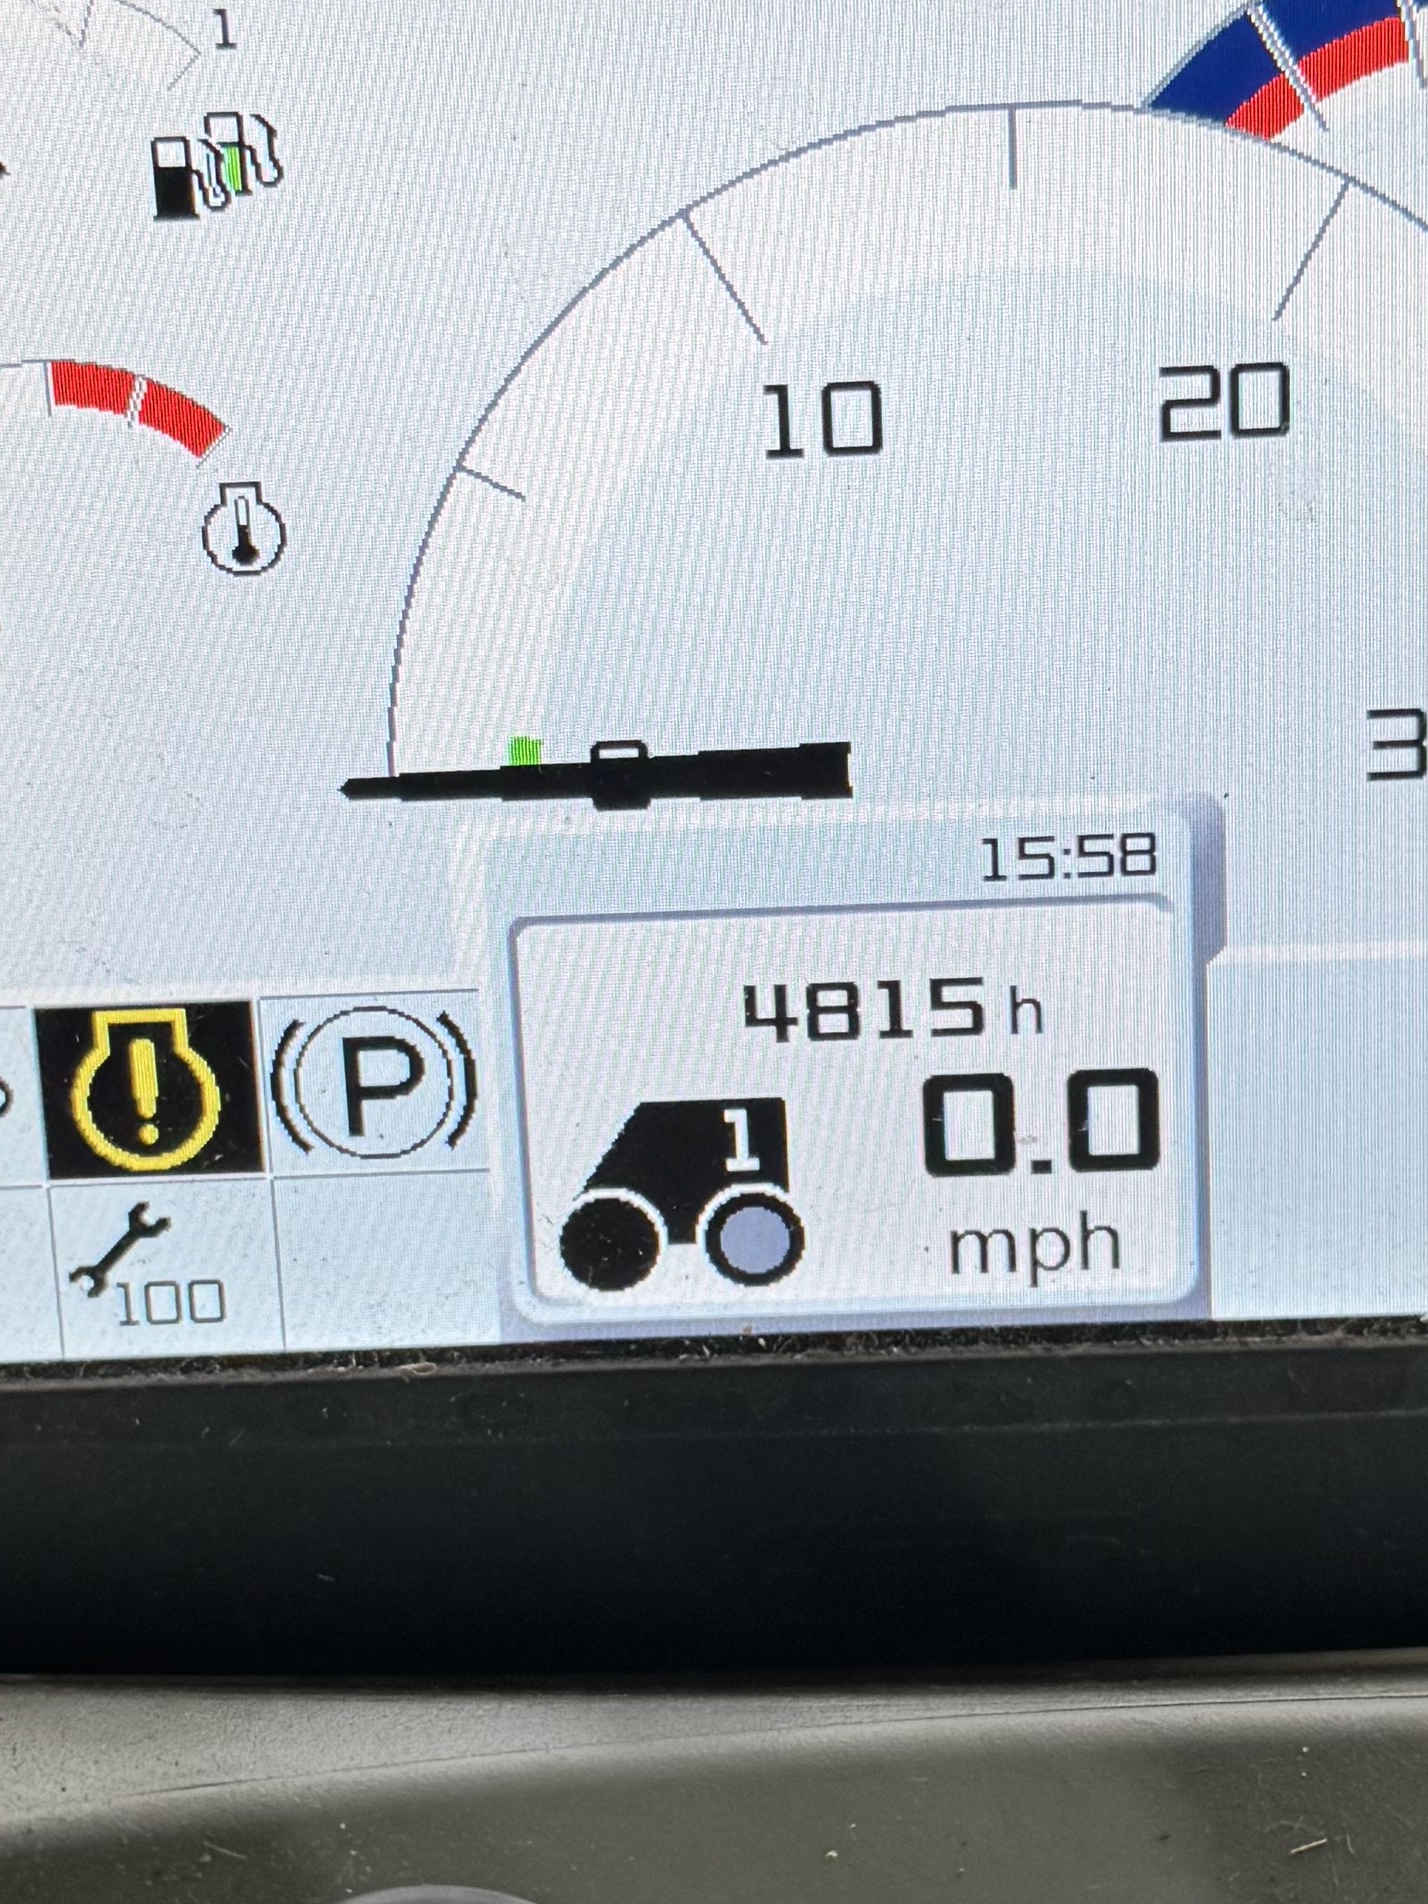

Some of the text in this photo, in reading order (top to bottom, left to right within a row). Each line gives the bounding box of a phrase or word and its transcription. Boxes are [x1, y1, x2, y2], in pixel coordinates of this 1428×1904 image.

[213, 8, 236, 50] 1
[764, 380, 883, 459] 10
[1160, 361, 1290, 441] 20
[982, 832, 1157, 882] 15:58
[744, 977, 1043, 1042] 4815 h
[342, 1034, 426, 1136] P
[722, 1108, 762, 1172] 1
[922, 1068, 1160, 1177] 0.0
[950, 1210, 1120, 1288] mph
[118, 1278, 226, 1327] 100
